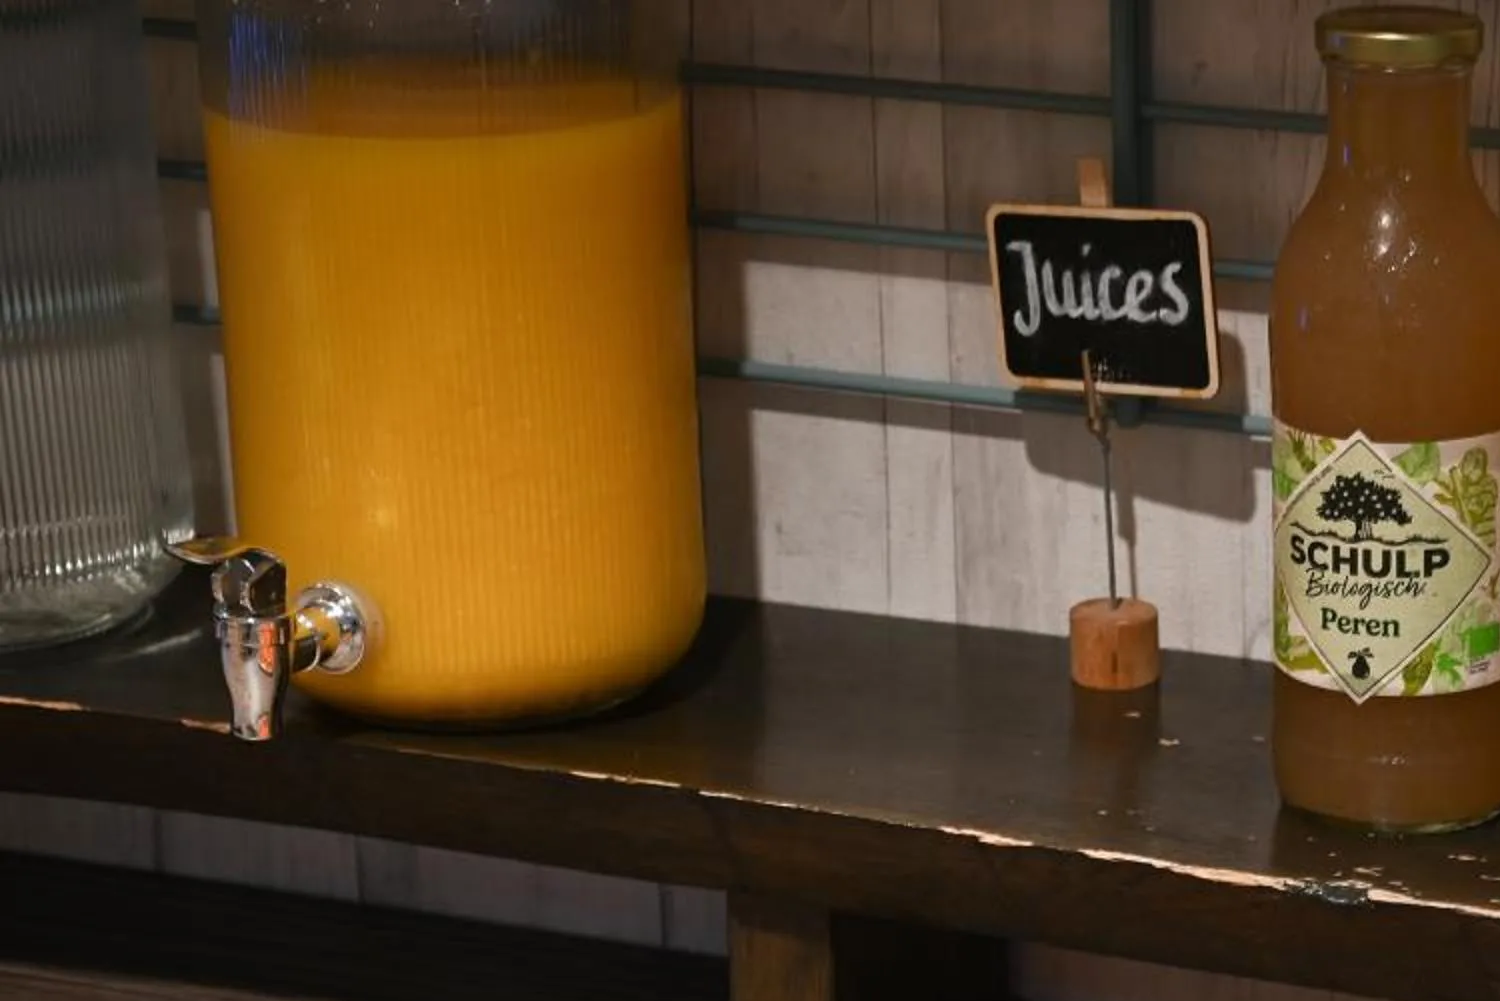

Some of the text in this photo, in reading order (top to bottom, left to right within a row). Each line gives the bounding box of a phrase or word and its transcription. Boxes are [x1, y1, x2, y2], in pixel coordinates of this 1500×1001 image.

[1006, 240, 1189, 336] Juices
[1290, 534, 1451, 579] SCHULP
[1305, 567, 1427, 610] Biologisch
[1321, 607, 1400, 637] Peren
